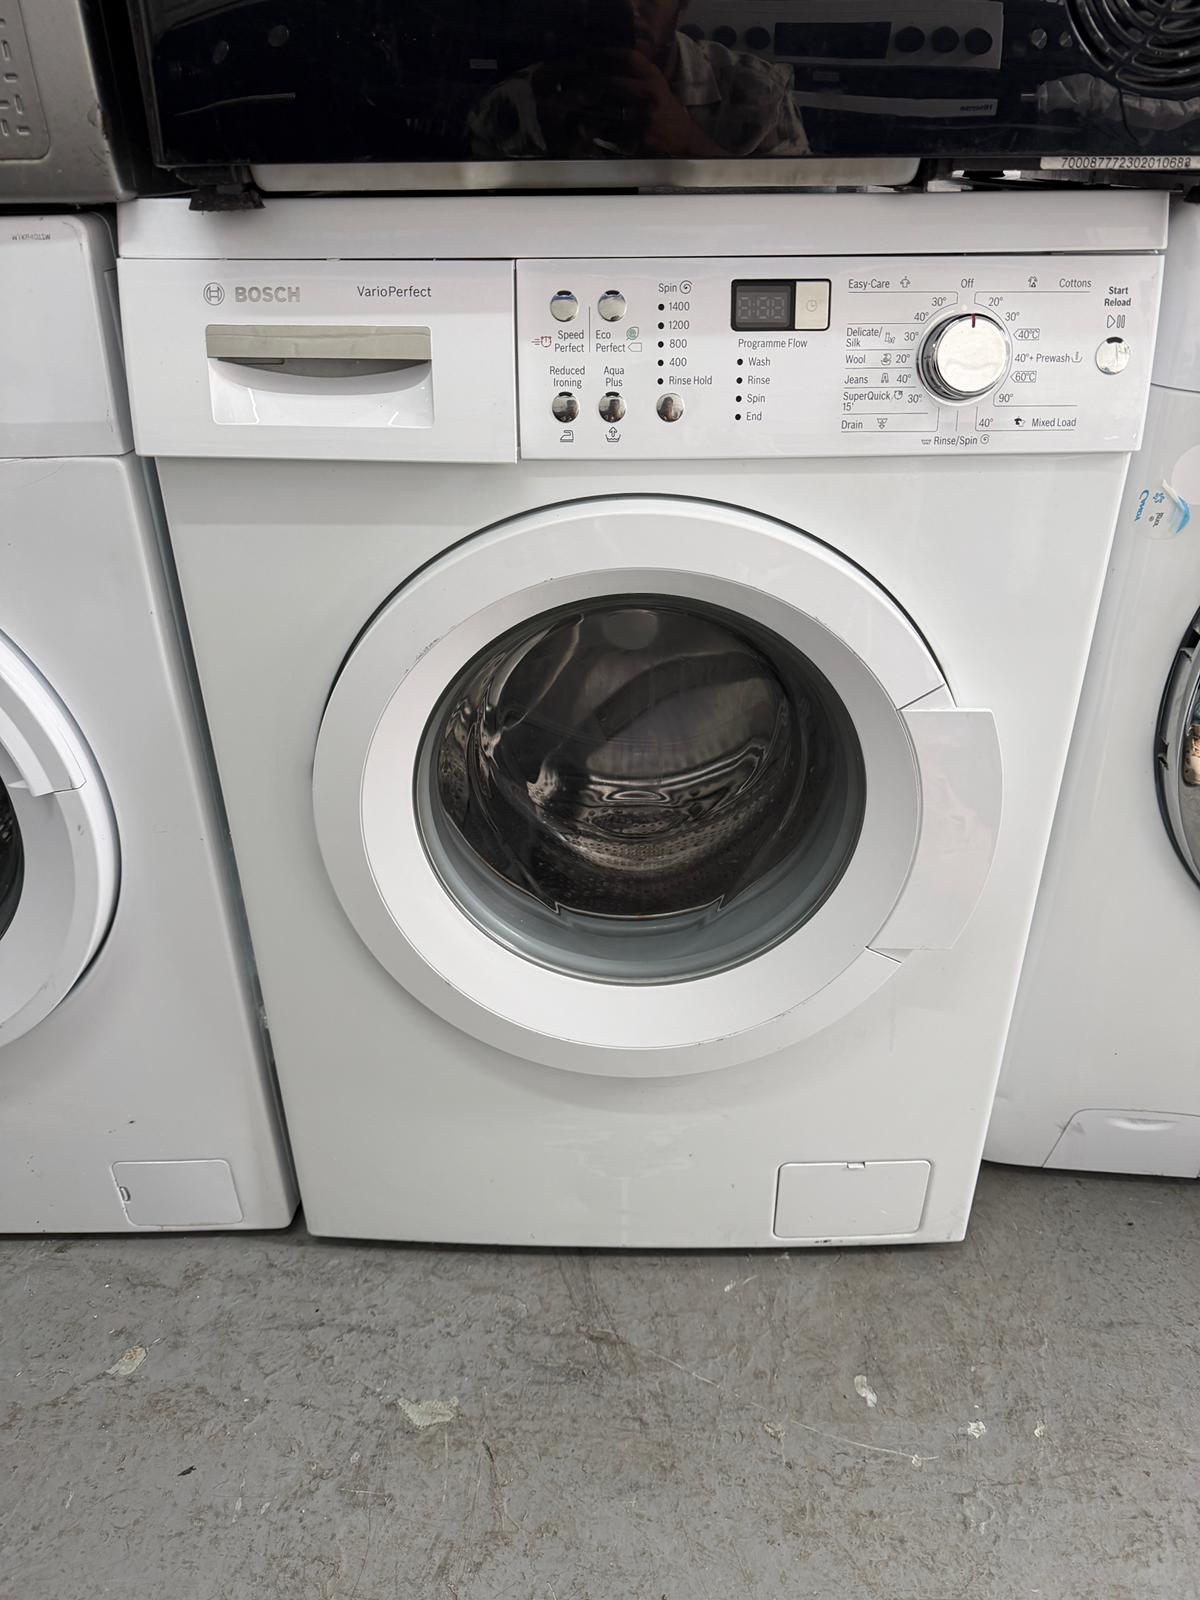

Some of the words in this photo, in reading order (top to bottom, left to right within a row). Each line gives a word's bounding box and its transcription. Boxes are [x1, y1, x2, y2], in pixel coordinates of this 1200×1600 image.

[848, 279, 890, 290] Easy-Care
[960, 278, 975, 289] Off
[1059, 278, 1092, 288] Cottons
[357, 285, 432, 298] VarioPerfect
[658, 283, 677, 294] Spin
[1108, 286, 1129, 295] Start
[235, 286, 300, 303] BOSCH
[668, 302, 690, 311] 1400
[988, 296, 1003, 307] 20°
[1104, 298, 1132, 307] Reload
[1005, 312, 1020, 322] 30°
[668, 320, 690, 330] 1200
[558, 330, 584, 341] Speed
[596, 330, 611, 340] Eco
[846, 326, 883, 338] Delicate/
[904, 331, 920, 342] 30°
[554, 343, 584, 352] Perfect
[596, 343, 626, 352] Perfect
[669, 339, 688, 348] 800
[738, 339, 786, 350] Programme
[788, 338, 808, 348] Flow
[846, 338, 861, 347] Silk
[669, 357, 687, 366] 400
[748, 357, 770, 366] Wash
[846, 354, 866, 364] Wool
[896, 354, 910, 364] 20°
[1036, 352, 1070, 362] Prewash
[550, 366, 586, 375] Reduced
[604, 366, 625, 377] Aqua
[553, 378, 582, 389] Ironing
[605, 378, 623, 387] Plus
[668, 376, 692, 385] Rinse
[693, 376, 712, 385] Hold
[748, 375, 770, 385] Rinse
[844, 374, 868, 384] Jeans
[896, 374, 912, 384] 40°
[746, 394, 766, 404] Spin
[843, 391, 890, 402] SuperQuick
[998, 393, 1014, 402] 90°
[746, 411, 762, 420] End
[842, 420, 864, 430] Drain
[978, 417, 994, 427] 40°
[1032, 418, 1056, 427] Mixed
[1058, 418, 1077, 427] Load
[934, 435, 978, 446] Rinse/Spin
